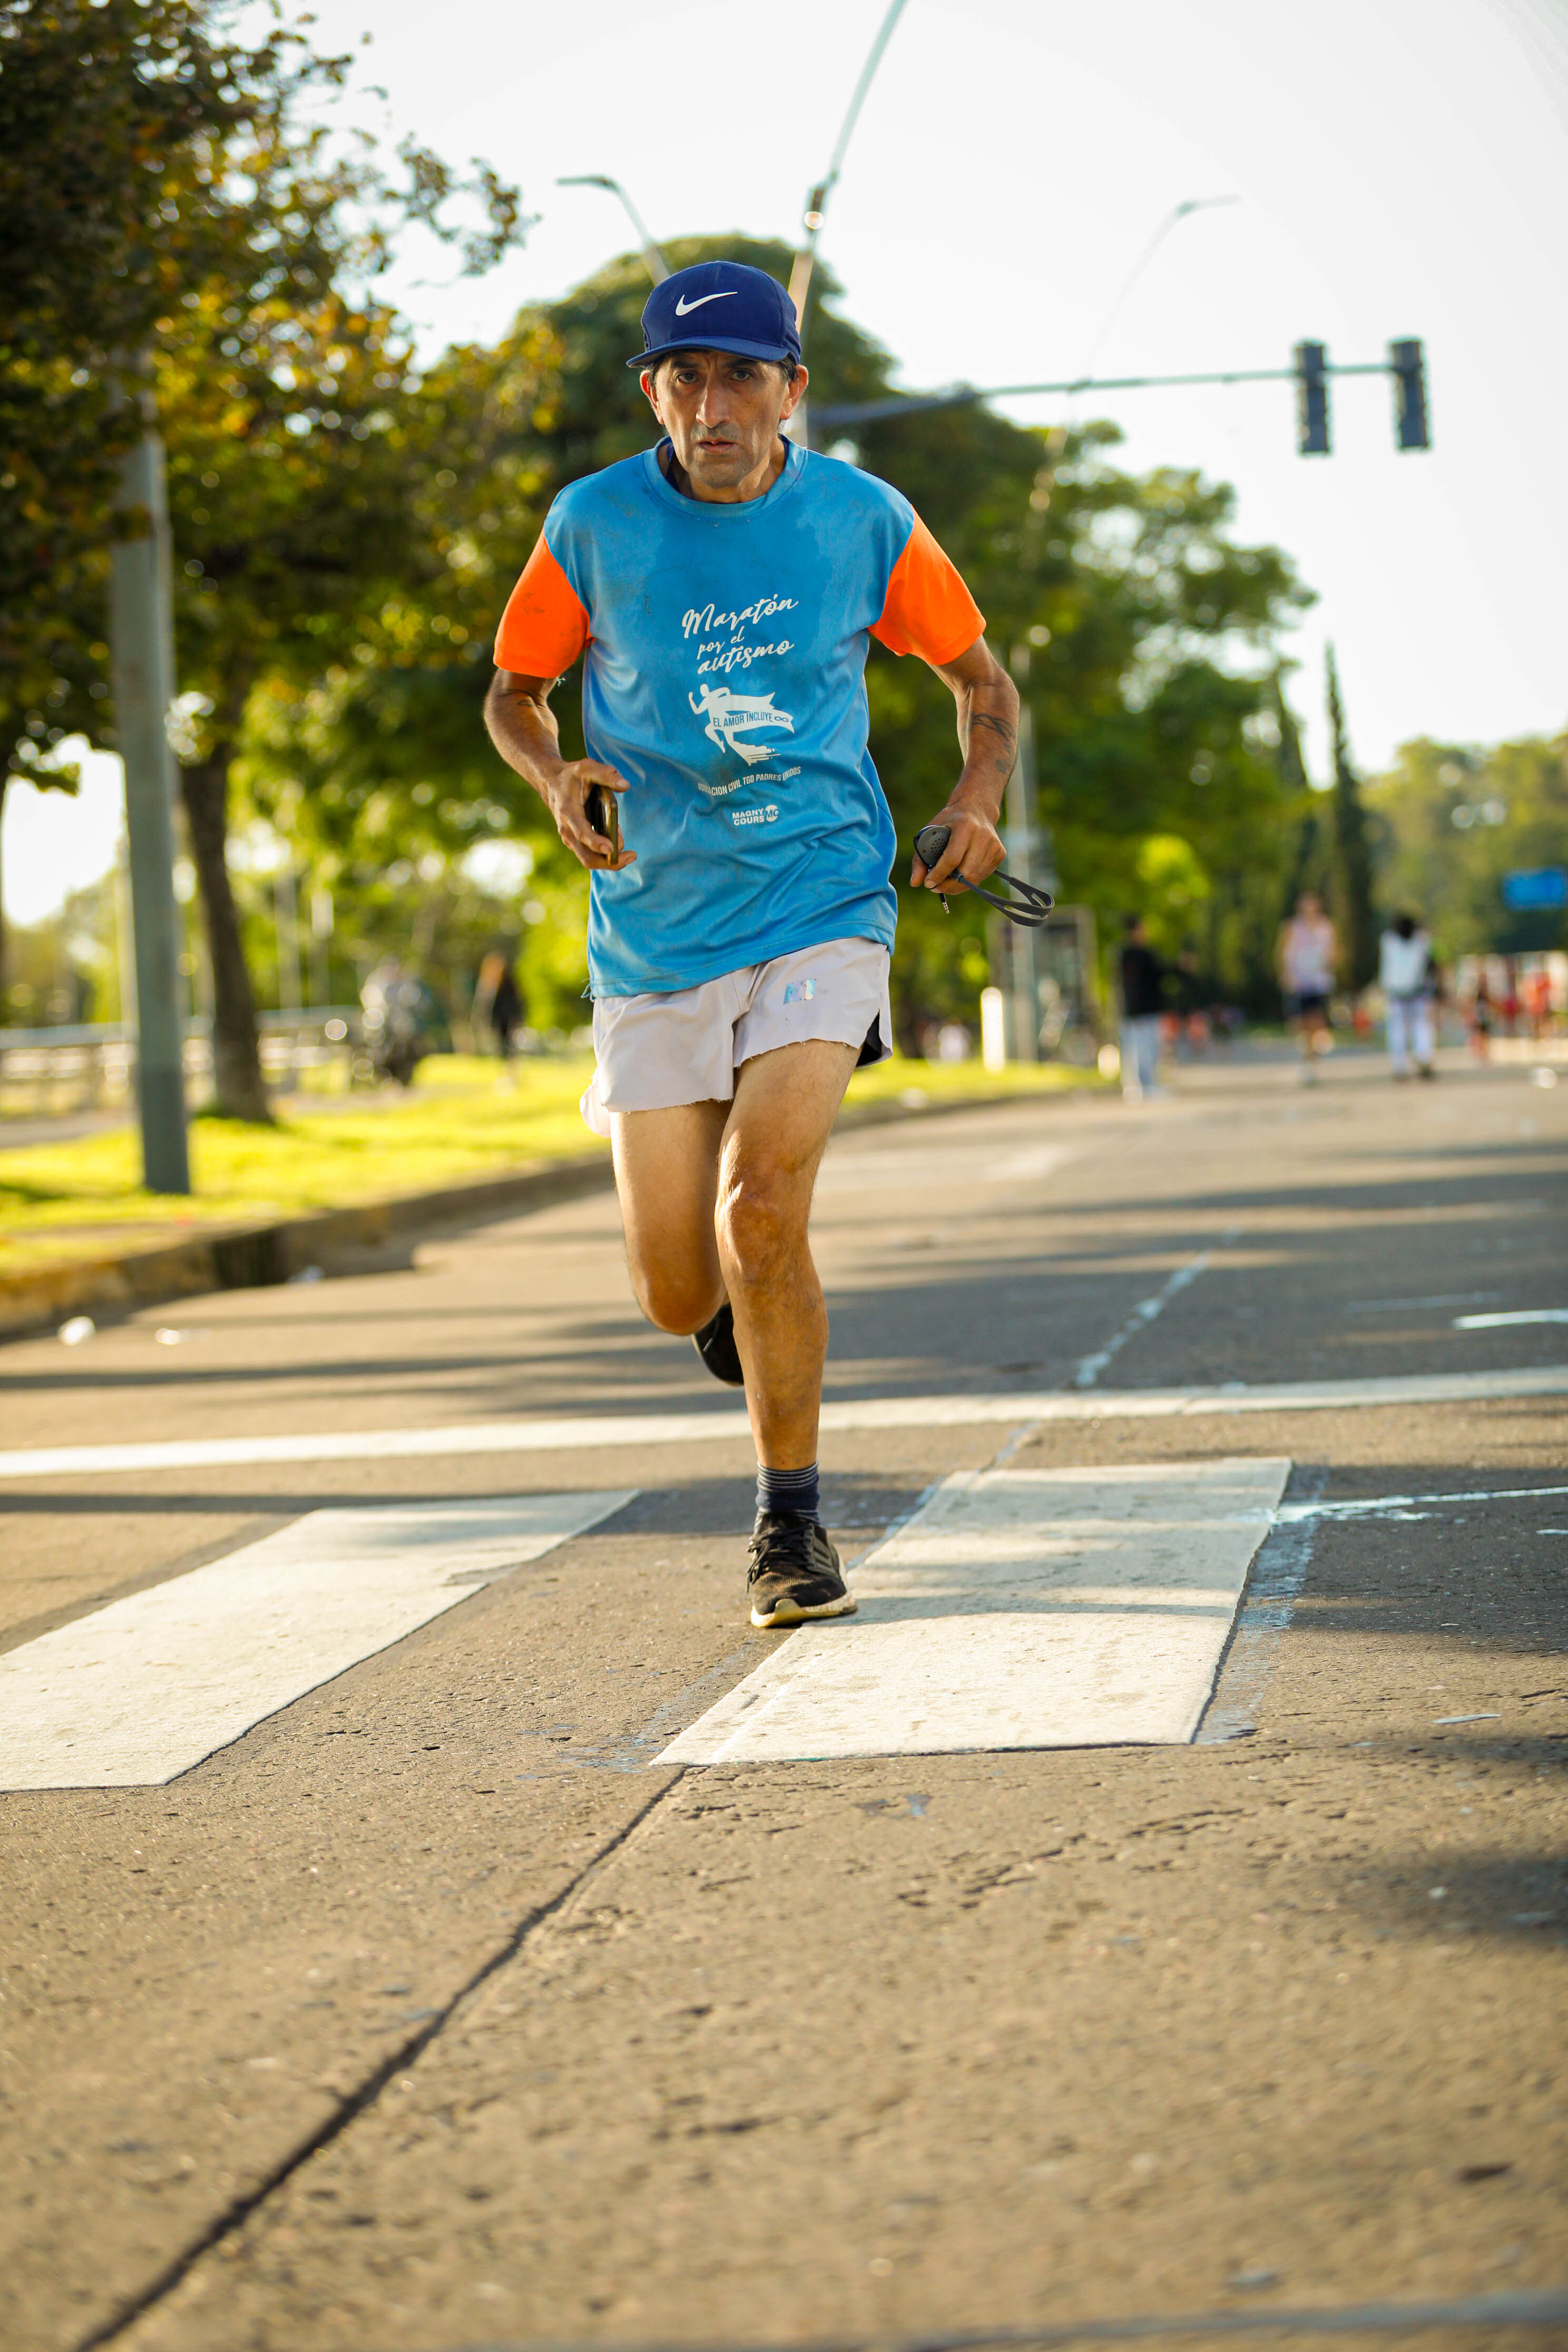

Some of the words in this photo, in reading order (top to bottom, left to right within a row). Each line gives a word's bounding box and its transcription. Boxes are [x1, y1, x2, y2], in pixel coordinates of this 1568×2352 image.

[682, 594, 799, 639] Maratón
[697, 641, 725, 660] por
[730, 625, 744, 644] el
[697, 640, 795, 674] autismo
[713, 718, 722, 727] EL
[723, 714, 744, 727] AMOR
[746, 711, 773, 722] INCLUYE
[728, 780, 742, 792] CIVIL
[742, 775, 754, 785] TGD
[782, 767, 801, 781] UNIDOS
[732, 808, 763, 819] MAGNY
[733, 815, 765, 826] COURS
